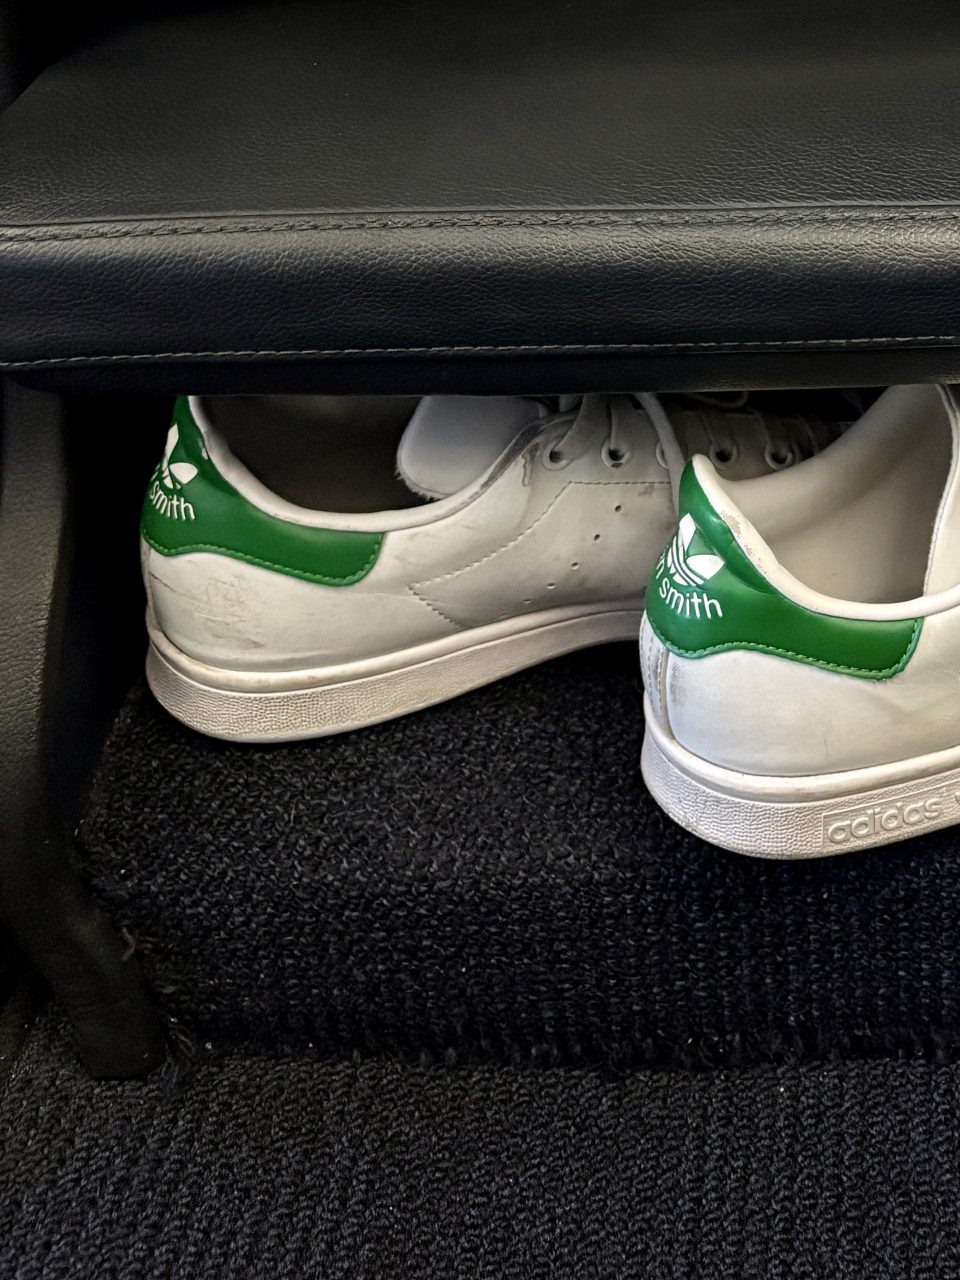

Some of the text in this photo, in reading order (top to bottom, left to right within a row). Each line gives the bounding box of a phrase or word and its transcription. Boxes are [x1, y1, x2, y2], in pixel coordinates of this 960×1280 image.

[149, 480, 196, 521] smith
[659, 577, 723, 619] smith
[827, 798, 943, 844] adidas
